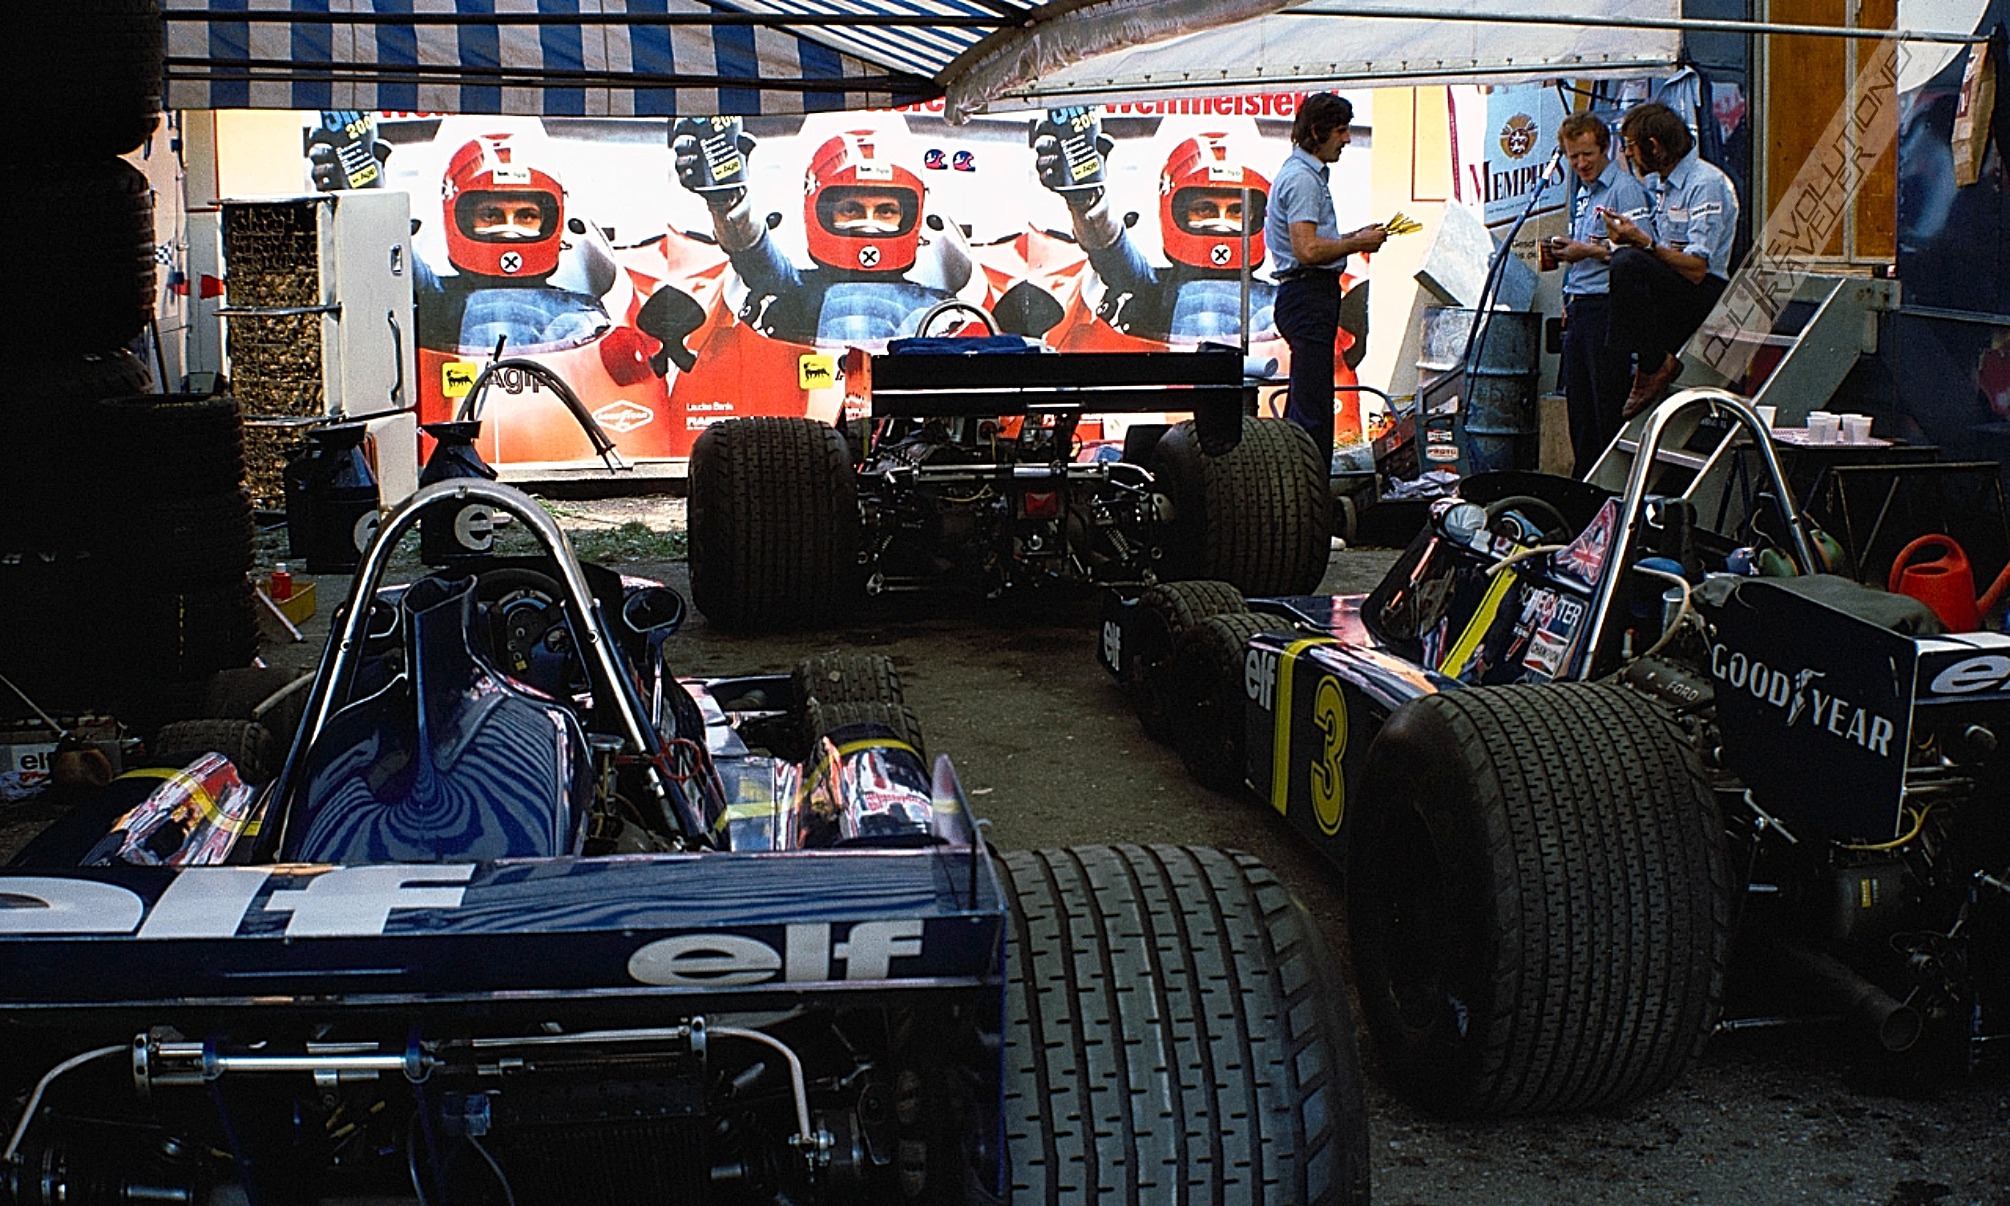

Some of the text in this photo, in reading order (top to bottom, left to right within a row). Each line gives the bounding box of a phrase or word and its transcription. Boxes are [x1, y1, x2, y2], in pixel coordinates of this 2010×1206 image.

[1103, 619, 1123, 672] elf
[1244, 648, 1277, 711] elf
[1665, 680, 1700, 702] FORD
[20, 751, 49, 770] el
[1310, 673, 1349, 837] 3
[626, 918, 926, 986] elf
